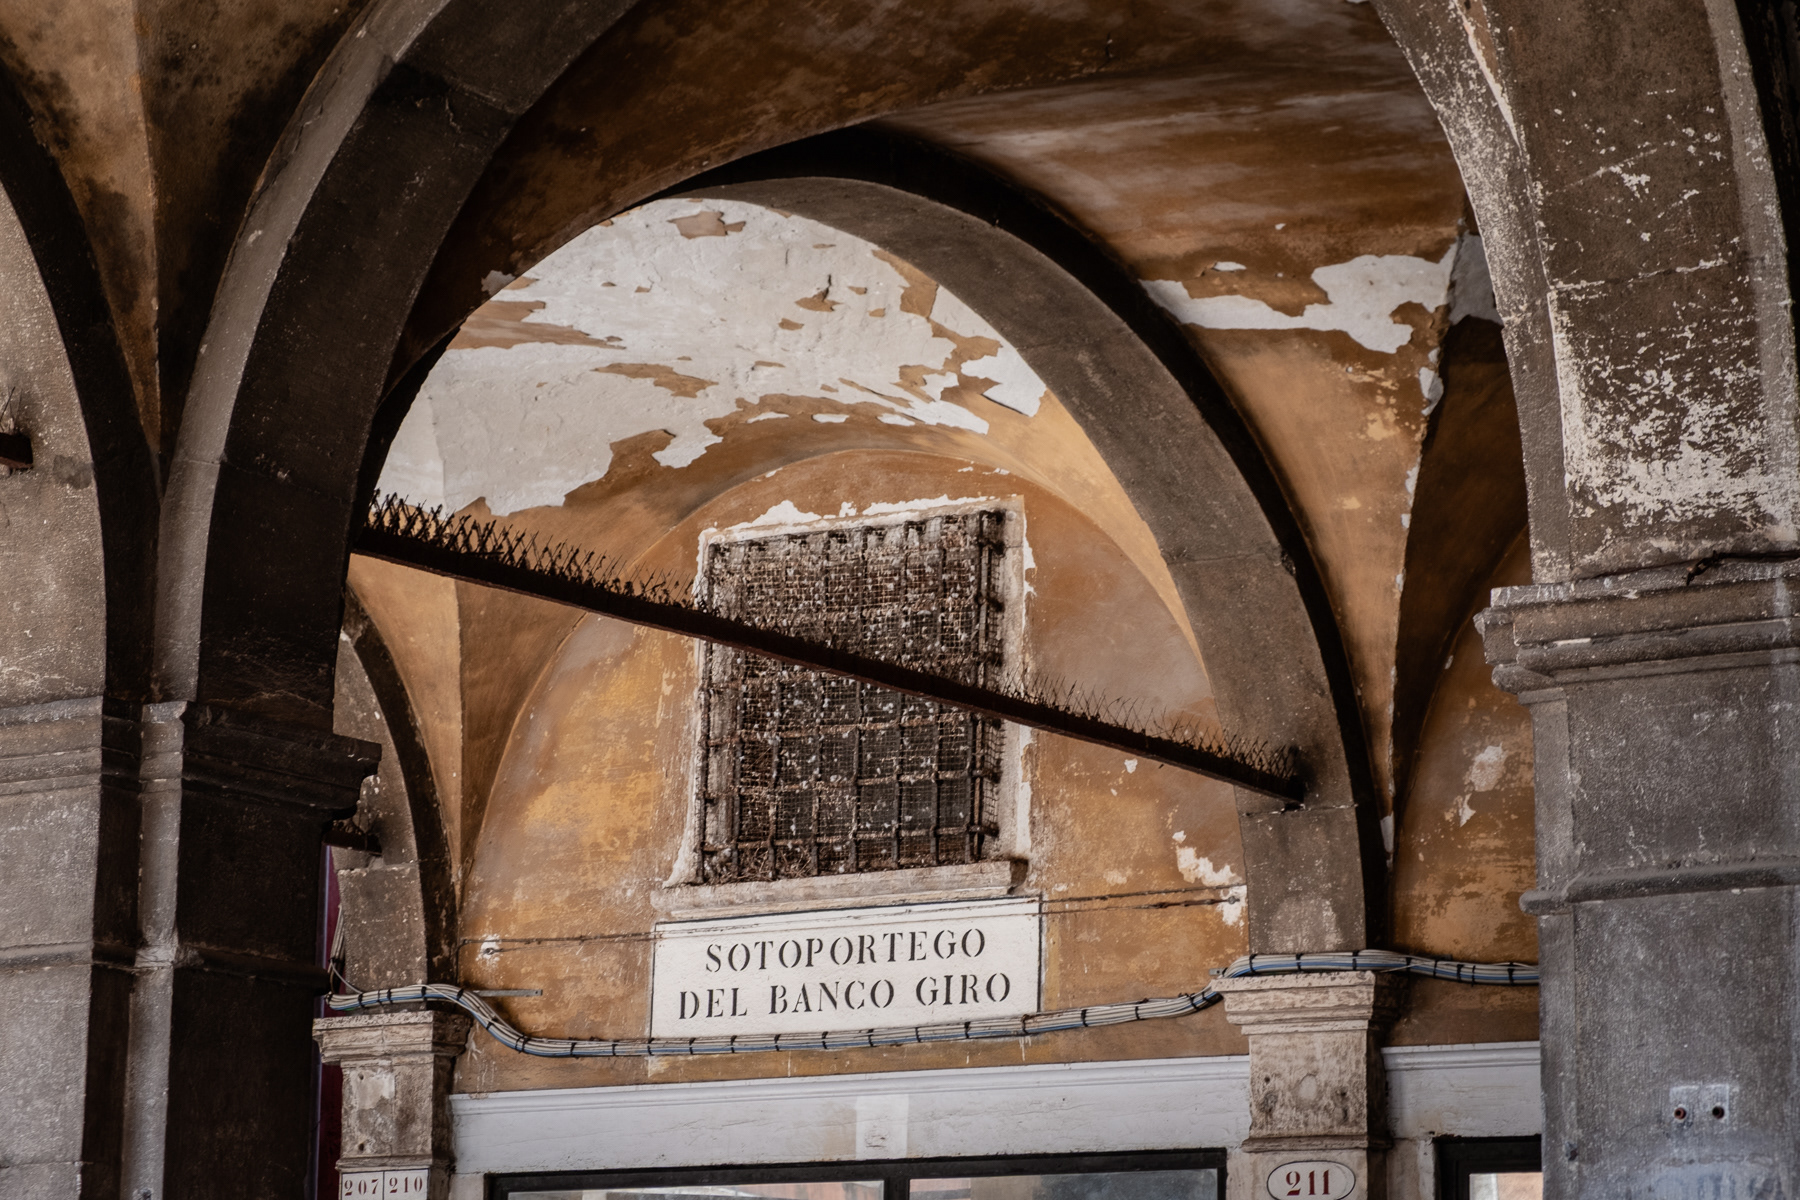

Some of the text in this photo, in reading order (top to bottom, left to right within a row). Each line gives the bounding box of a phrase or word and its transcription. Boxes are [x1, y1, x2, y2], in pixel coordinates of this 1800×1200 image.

[705, 928, 986, 973] SOTOPORTEGO
[678, 972, 1011, 1020] DEL BANCO GIRO
[344, 1178, 379, 1196] 207
[389, 1176, 423, 1194] 210
[1286, 1169, 1330, 1196] 211
